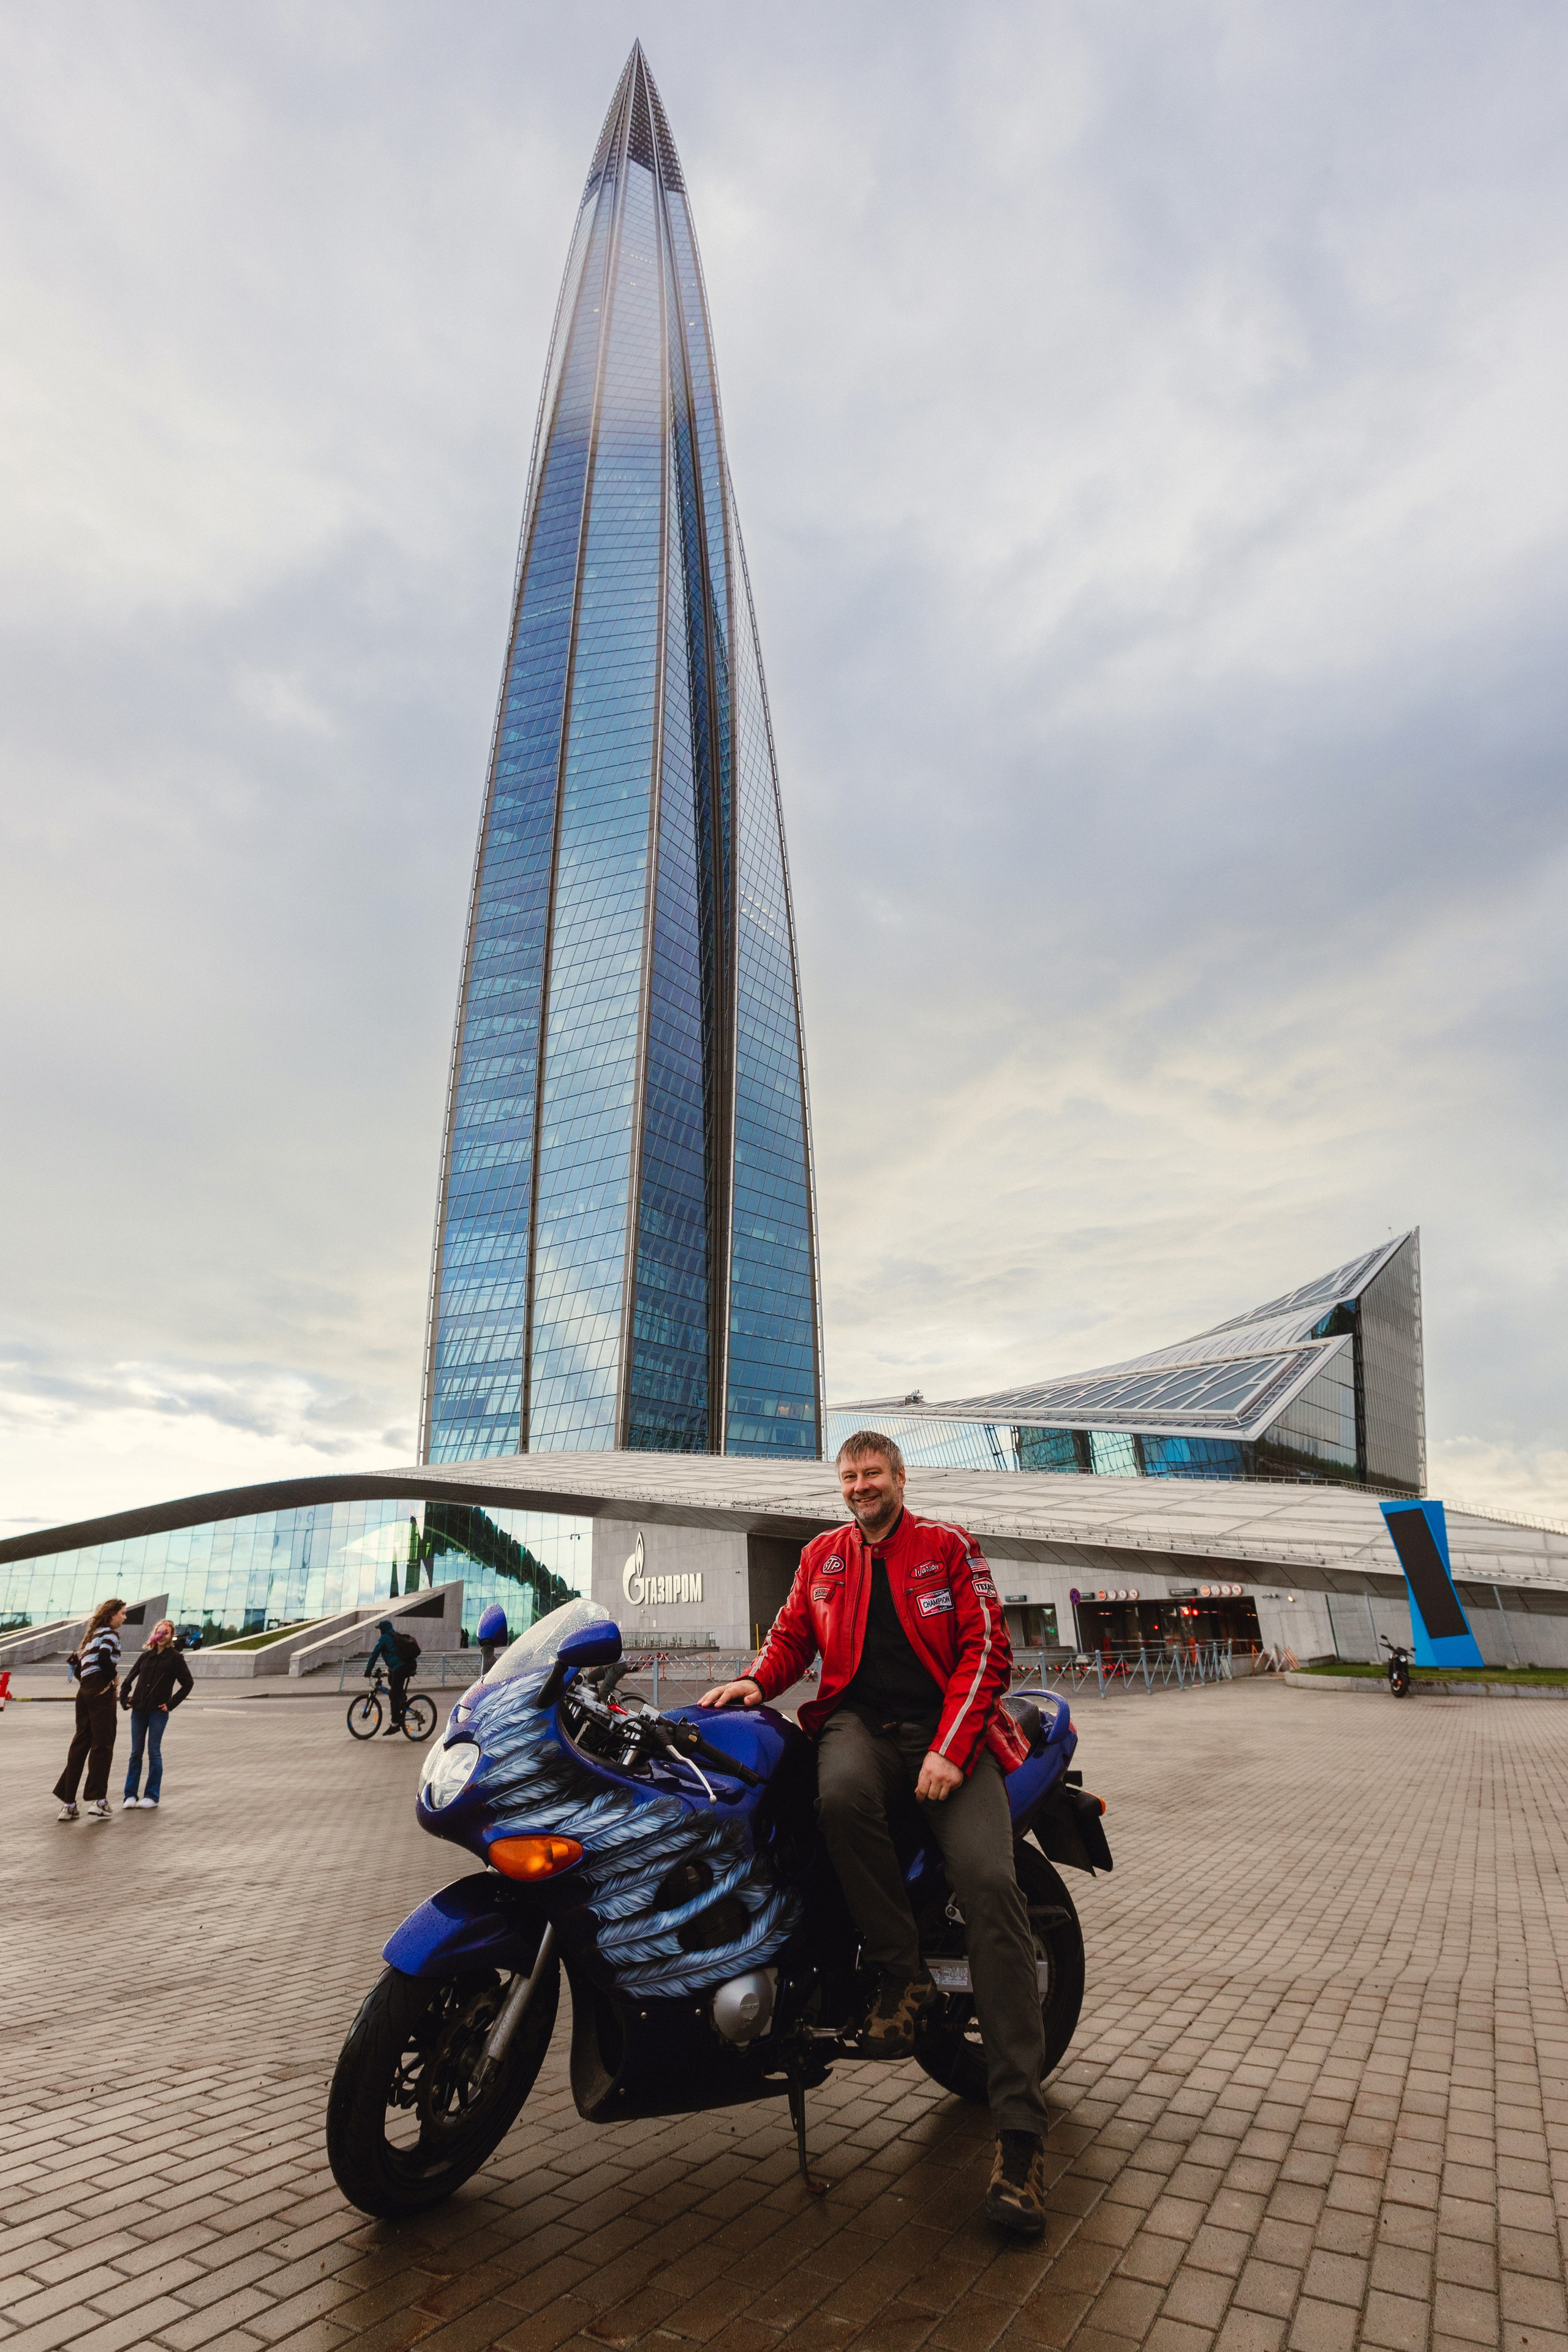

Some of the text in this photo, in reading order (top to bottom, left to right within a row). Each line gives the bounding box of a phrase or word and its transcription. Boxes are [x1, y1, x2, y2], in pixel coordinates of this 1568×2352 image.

[824, 1558, 841, 1570] STP
[644, 1572, 703, 1605] ГАЗПРОМ
[923, 1596, 950, 1608] CHAMPION
